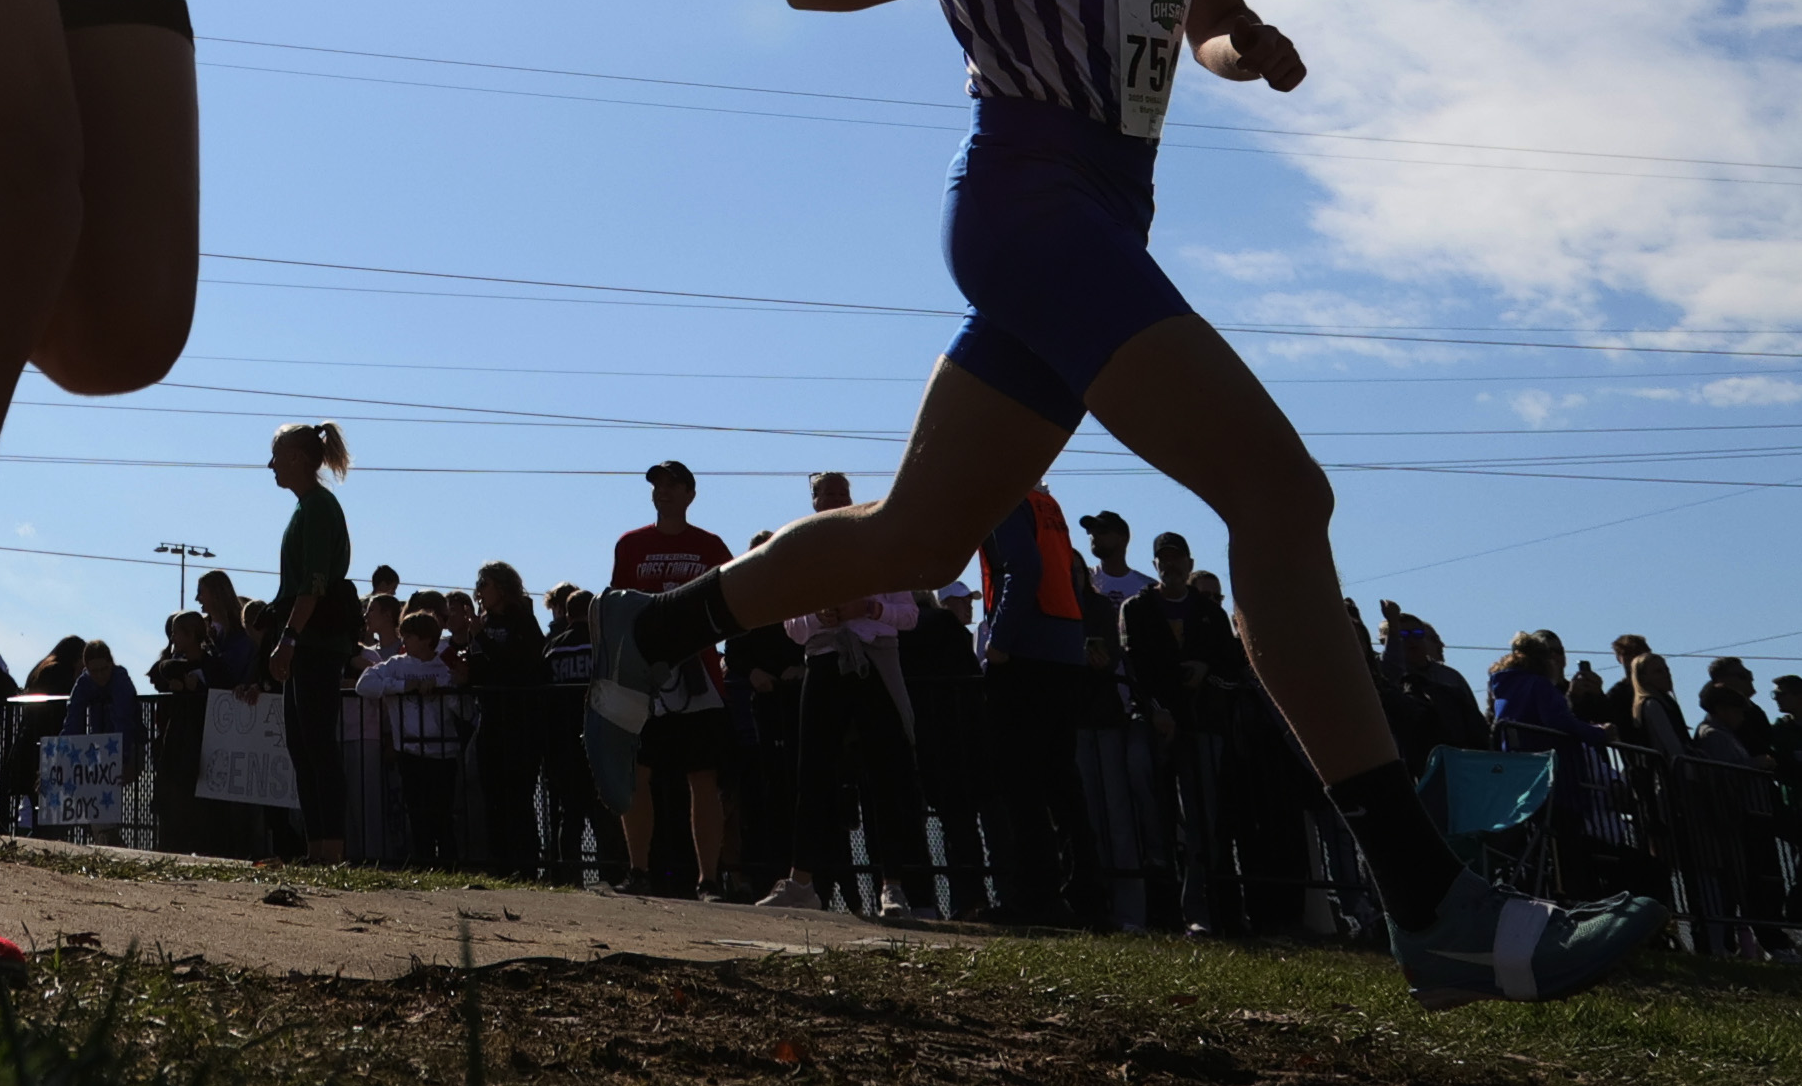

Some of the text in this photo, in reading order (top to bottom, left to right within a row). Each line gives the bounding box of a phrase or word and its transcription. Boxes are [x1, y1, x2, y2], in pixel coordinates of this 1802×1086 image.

[637, 561, 708, 579] CROSS COUNTRY
[212, 692, 258, 735] GO
[49, 765, 63, 786] GO
[206, 748, 297, 801] GENS
[63, 796, 100, 822] BOYS
